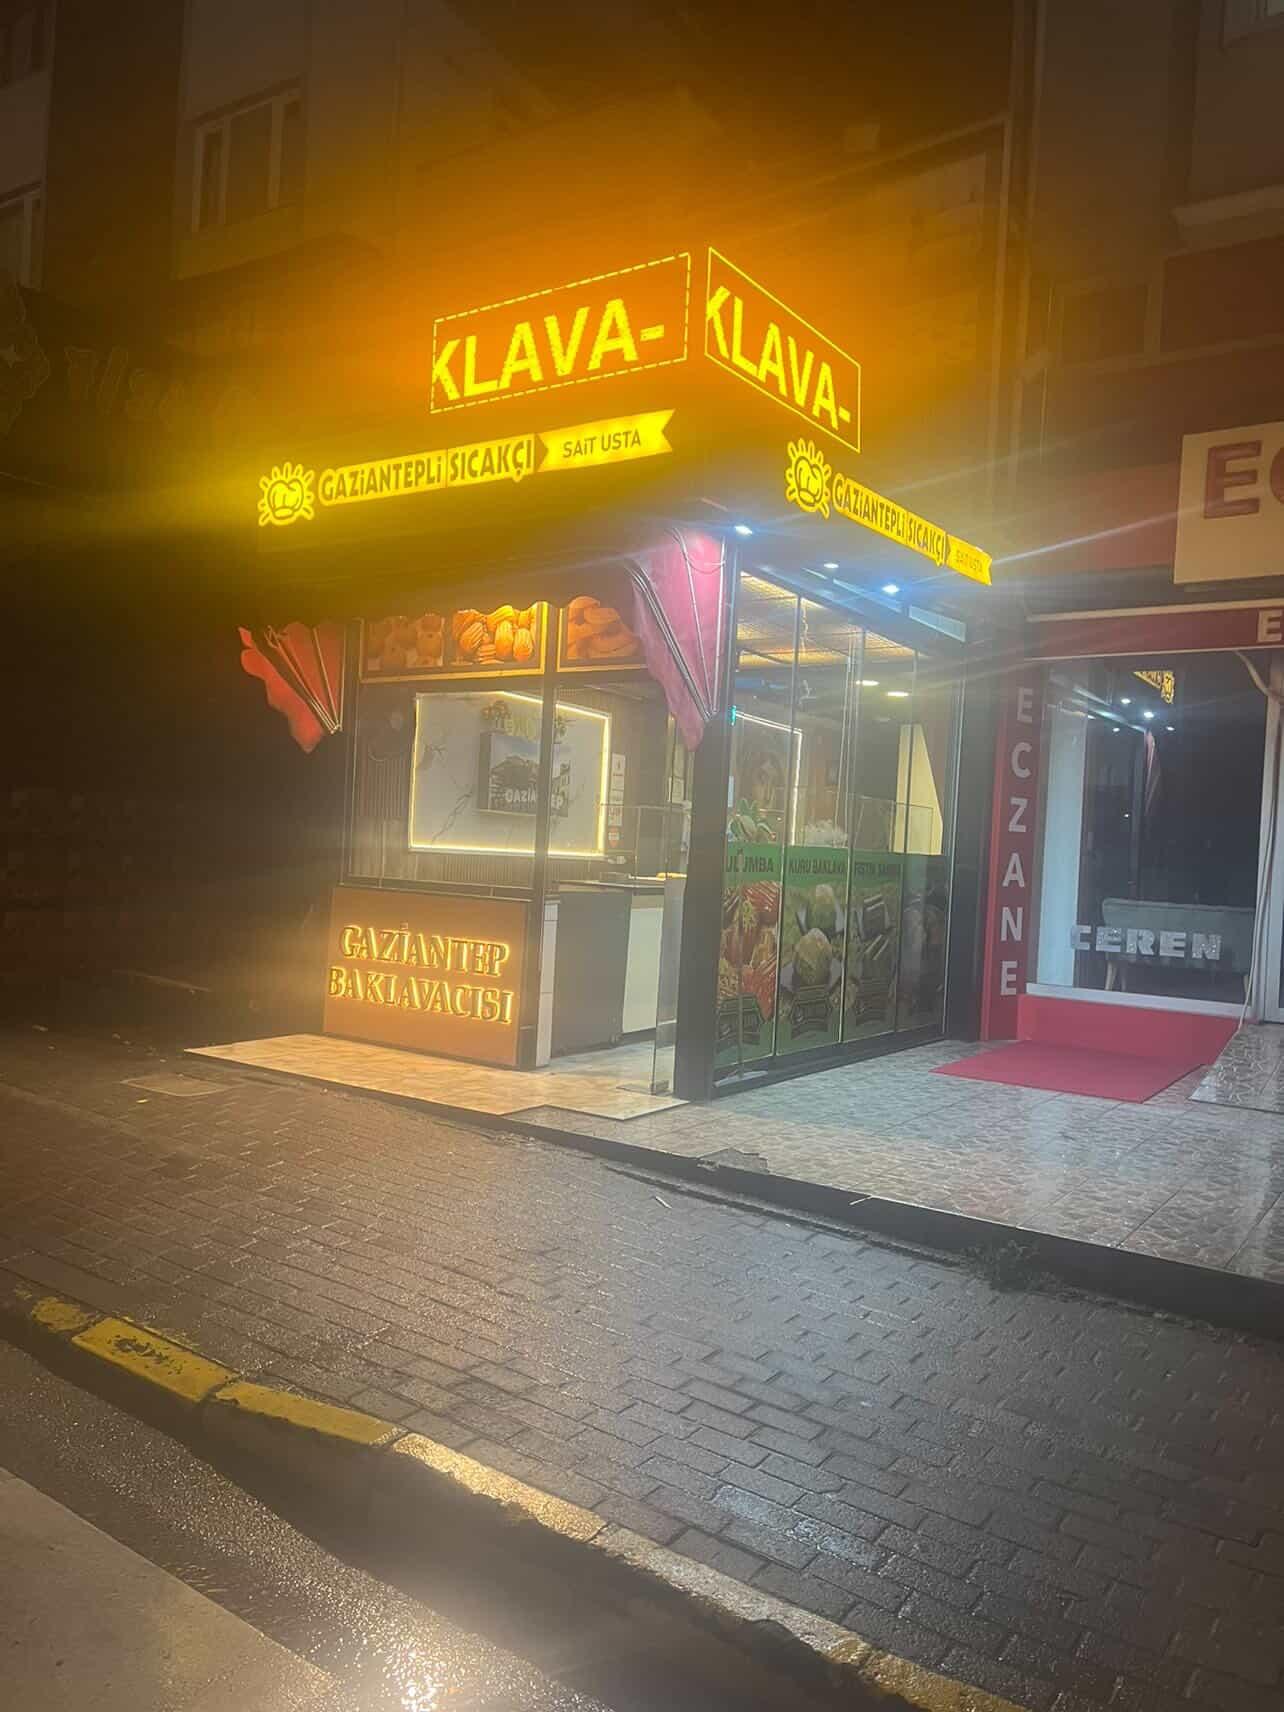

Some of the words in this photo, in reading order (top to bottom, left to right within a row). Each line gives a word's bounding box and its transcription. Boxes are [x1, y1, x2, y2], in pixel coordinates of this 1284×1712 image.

[601, 429, 641, 450] USTA
[1203, 440, 1284, 519] E
[1000, 688, 1033, 997] ECZANE
[341, 922, 510, 977] GAZİANTEP
[1070, 924, 1222, 961] CEREN
[329, 965, 514, 1025] BAKLAVACISI
